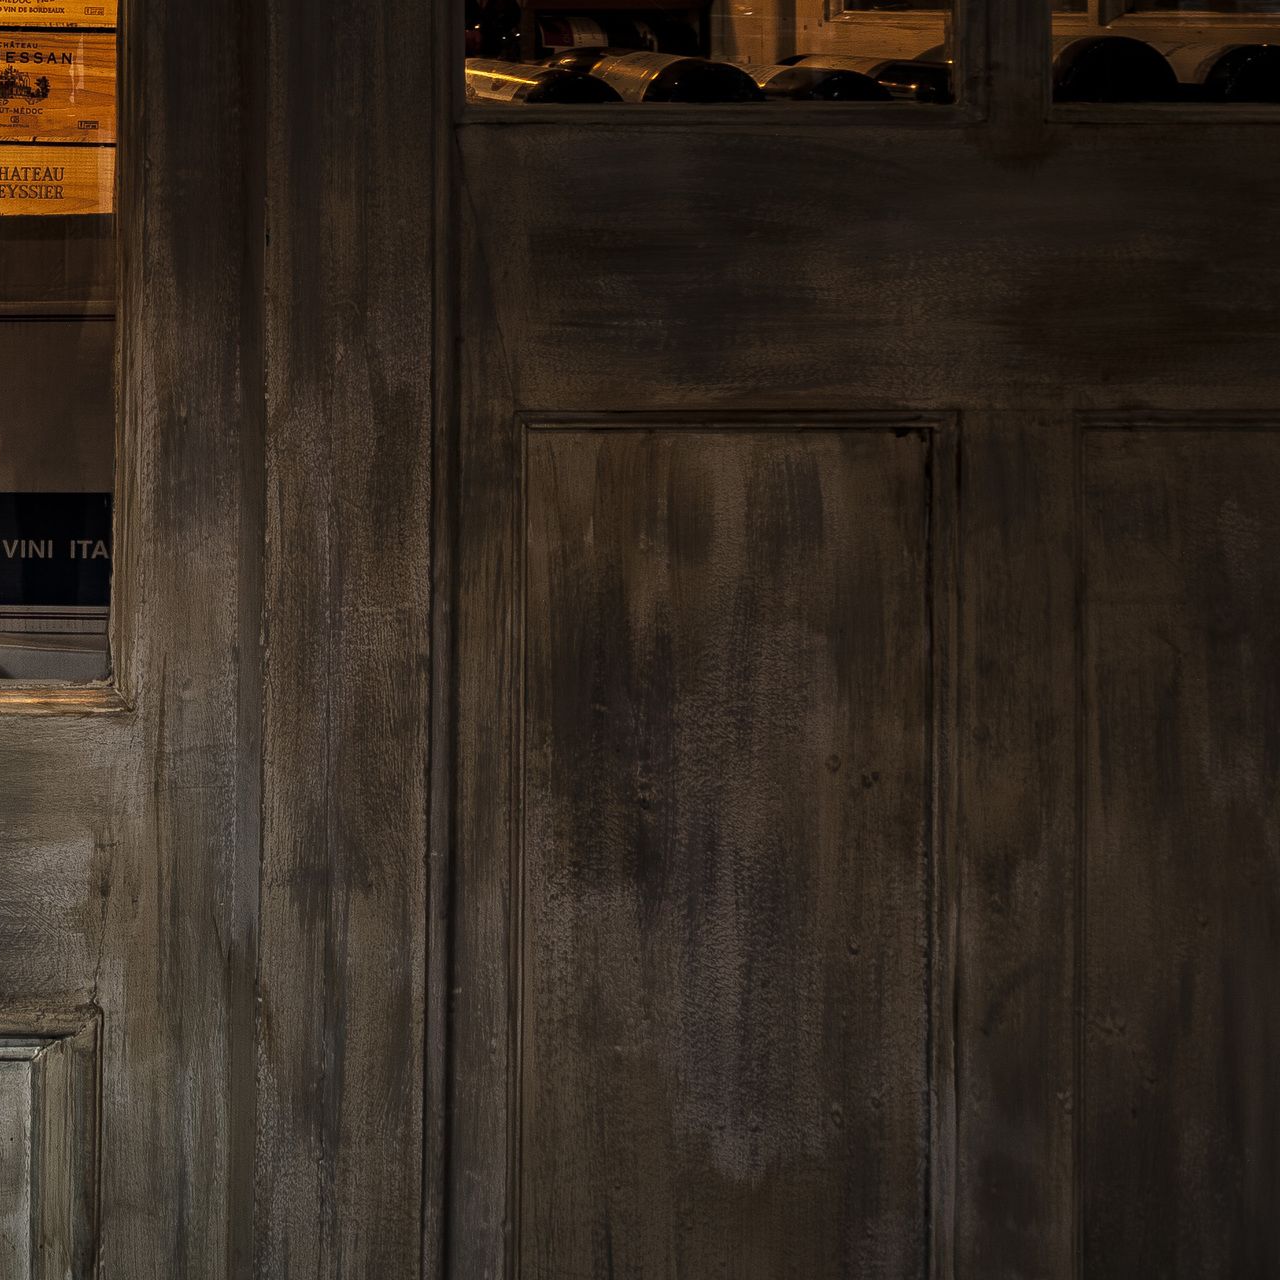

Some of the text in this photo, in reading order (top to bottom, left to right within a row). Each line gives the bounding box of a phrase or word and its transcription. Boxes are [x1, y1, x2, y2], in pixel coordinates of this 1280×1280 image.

[29, 6, 65, 14] BORDEAUX
[2, 539, 109, 559] VINI ITA
